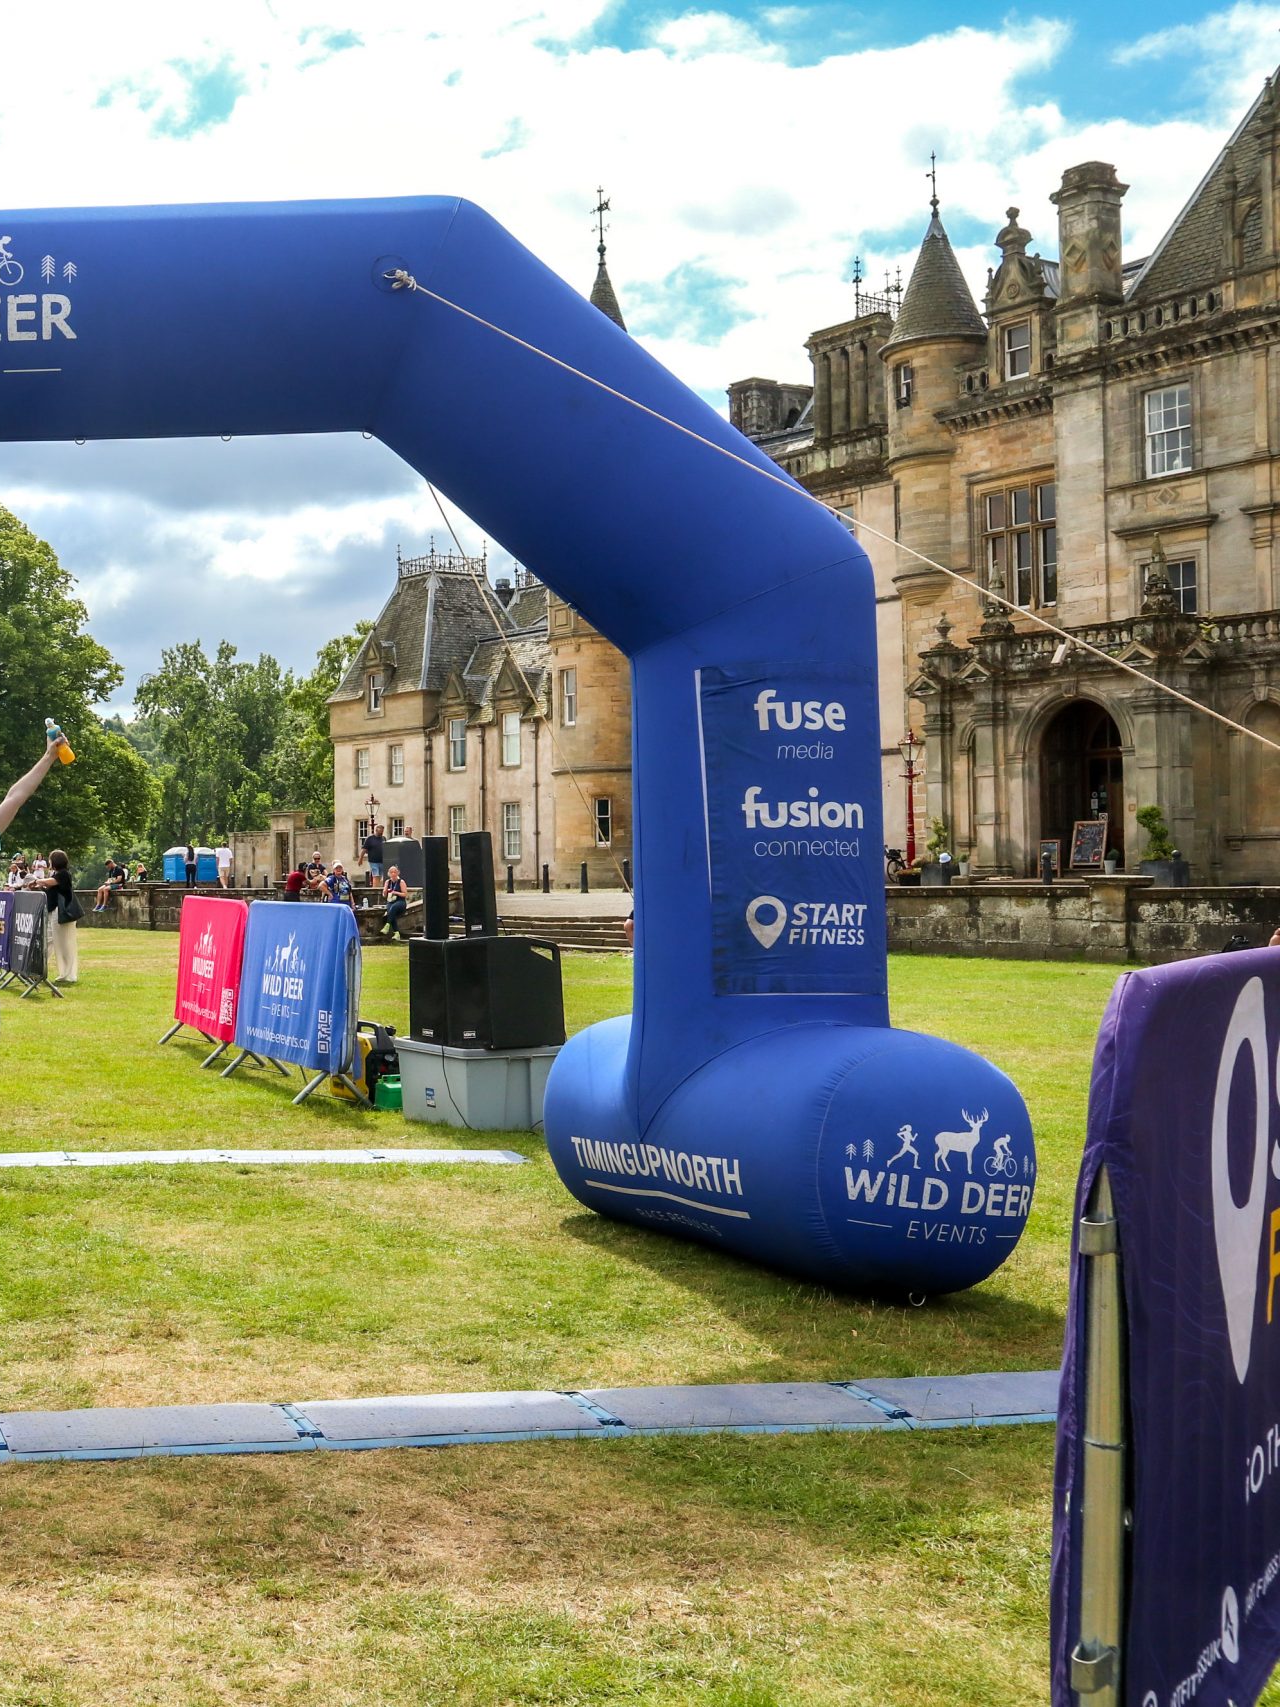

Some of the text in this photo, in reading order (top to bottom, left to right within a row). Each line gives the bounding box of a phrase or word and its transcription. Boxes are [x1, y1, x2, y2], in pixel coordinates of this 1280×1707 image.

[753, 689, 846, 732] fuse
[777, 741, 834, 760] media
[741, 786, 864, 829] fusion
[754, 837, 860, 857] connected
[791, 902, 868, 926] START
[788, 928, 865, 946] FITNESS
[262, 973, 304, 1000] WILD DEER
[571, 1136, 744, 1196] TIMINGUPNORTH
[844, 1166, 1031, 1217] WILD DEER
[906, 1220, 987, 1246] EVENTS
